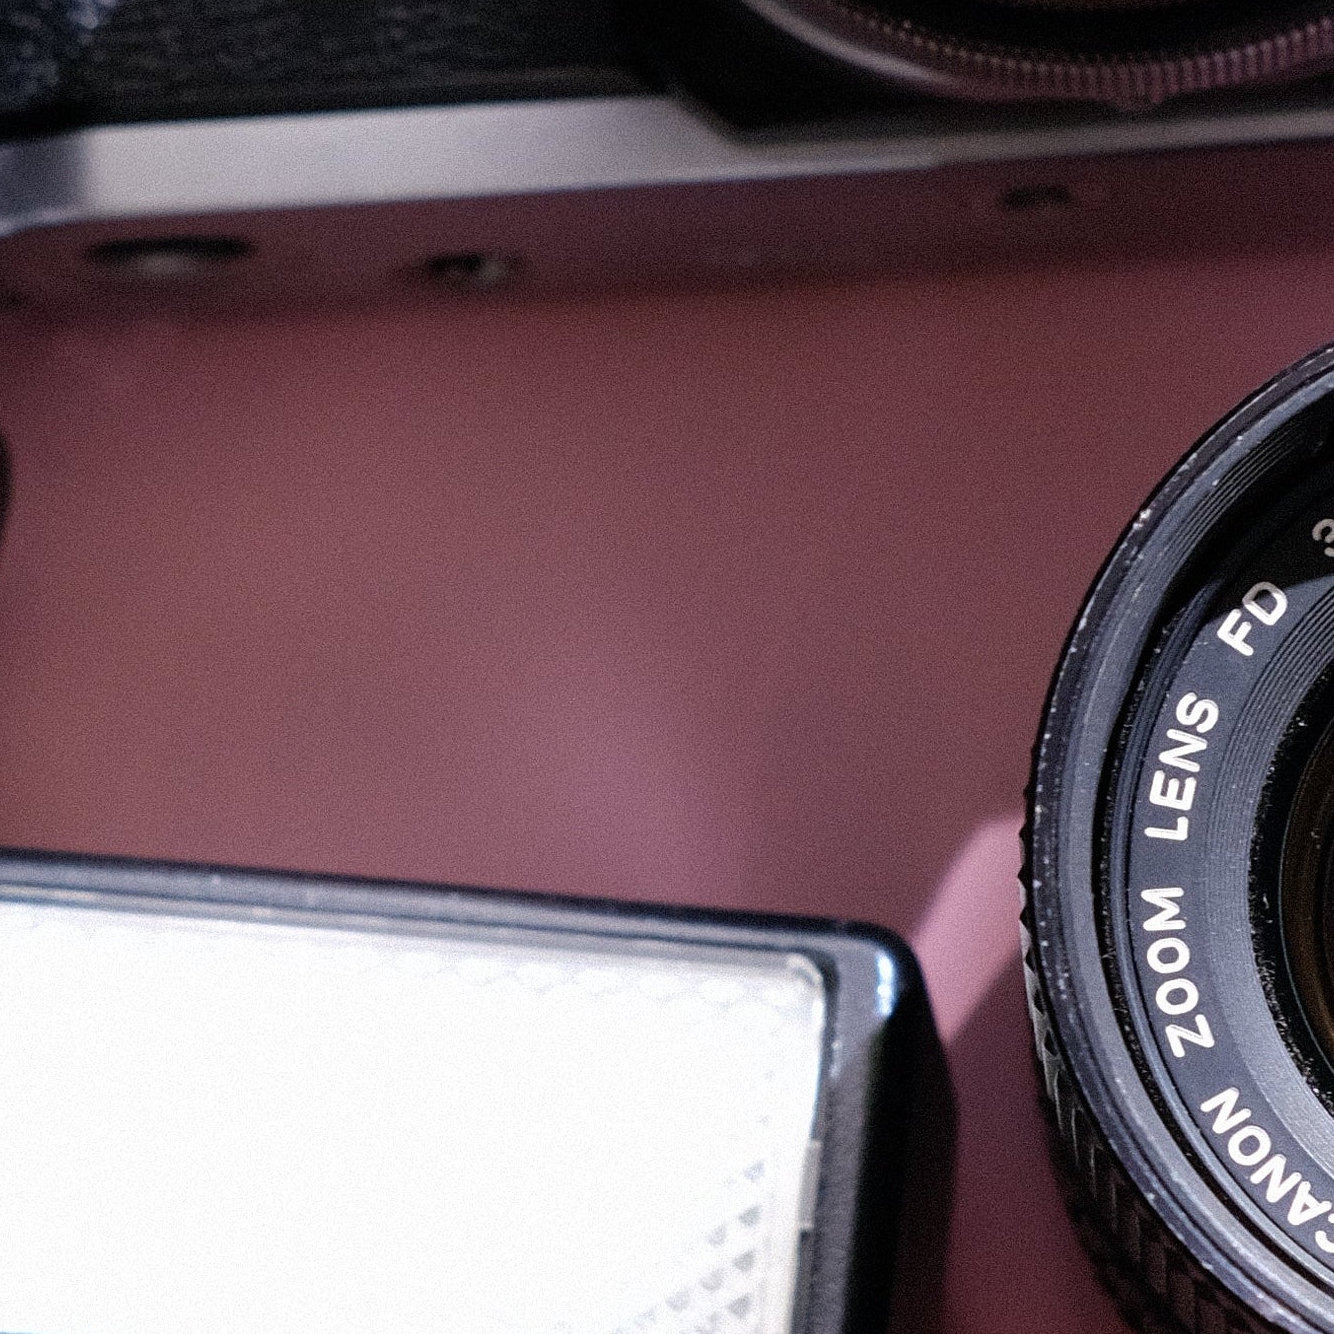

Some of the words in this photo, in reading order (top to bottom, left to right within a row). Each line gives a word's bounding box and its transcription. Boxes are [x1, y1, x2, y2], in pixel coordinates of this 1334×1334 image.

[1216, 580, 1289, 659] FD
[1144, 691, 1220, 842] LENS
[1141, 886, 1217, 1059] ZOOM
